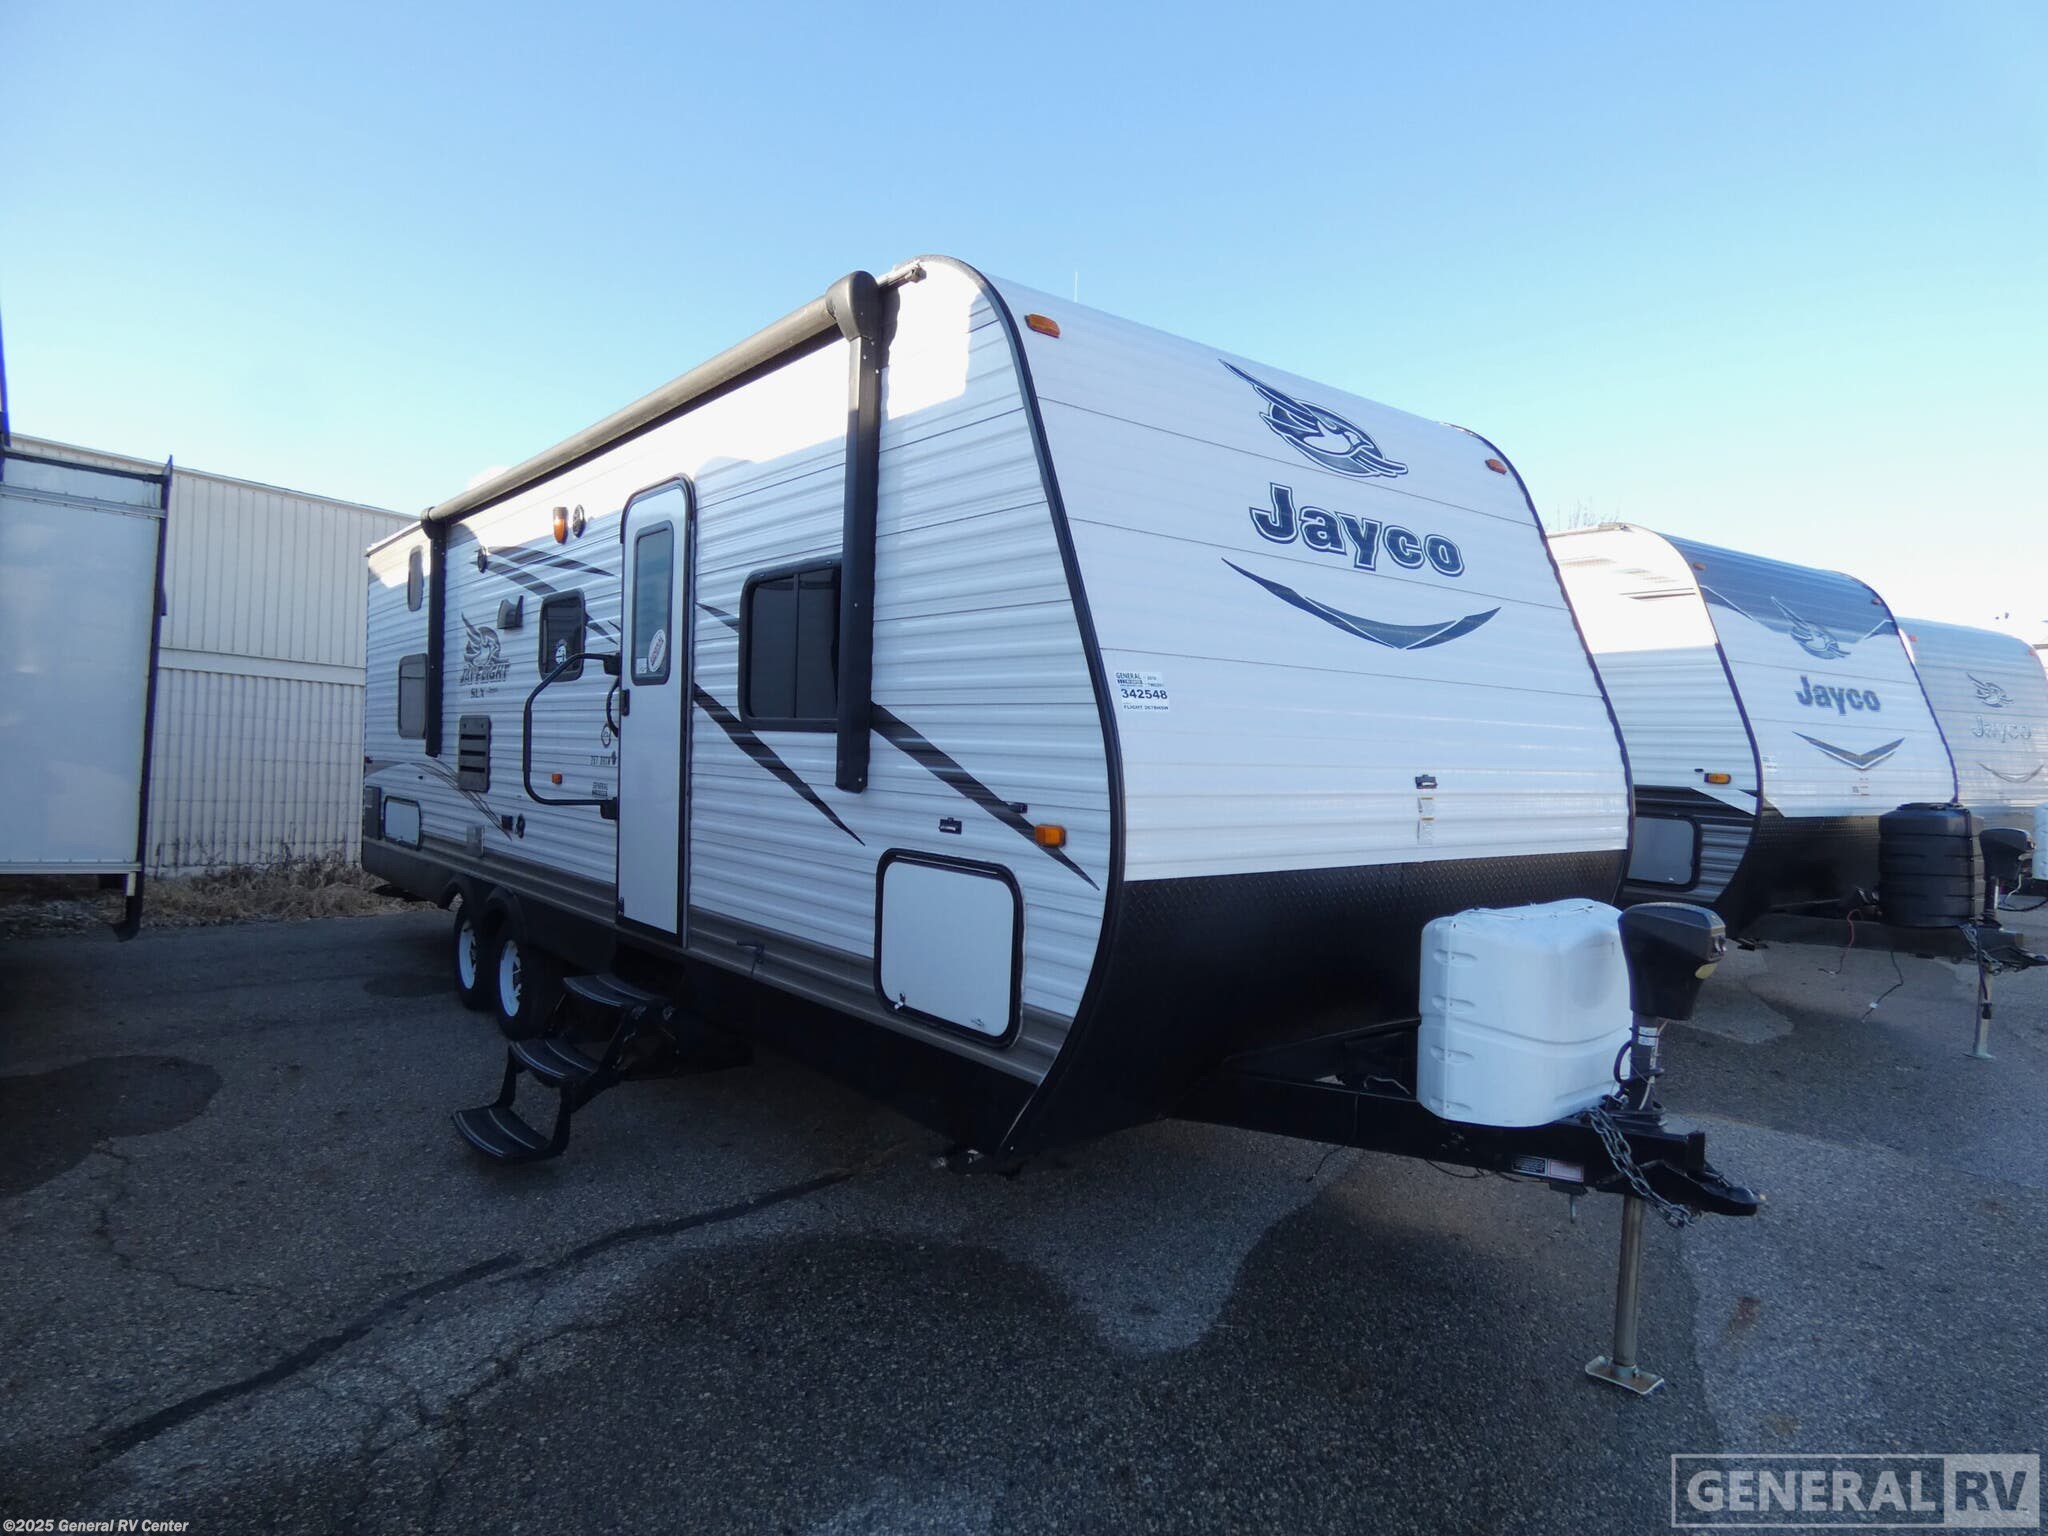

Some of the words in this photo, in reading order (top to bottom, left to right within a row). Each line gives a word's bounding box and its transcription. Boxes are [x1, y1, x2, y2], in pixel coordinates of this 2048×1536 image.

[1249, 482, 1465, 577] Jayco
[1115, 672, 1142, 680] GENERAL
[1121, 688, 1168, 700] 342548
[1795, 675, 1881, 716] Jayco
[1970, 715, 2032, 743] Jayco
